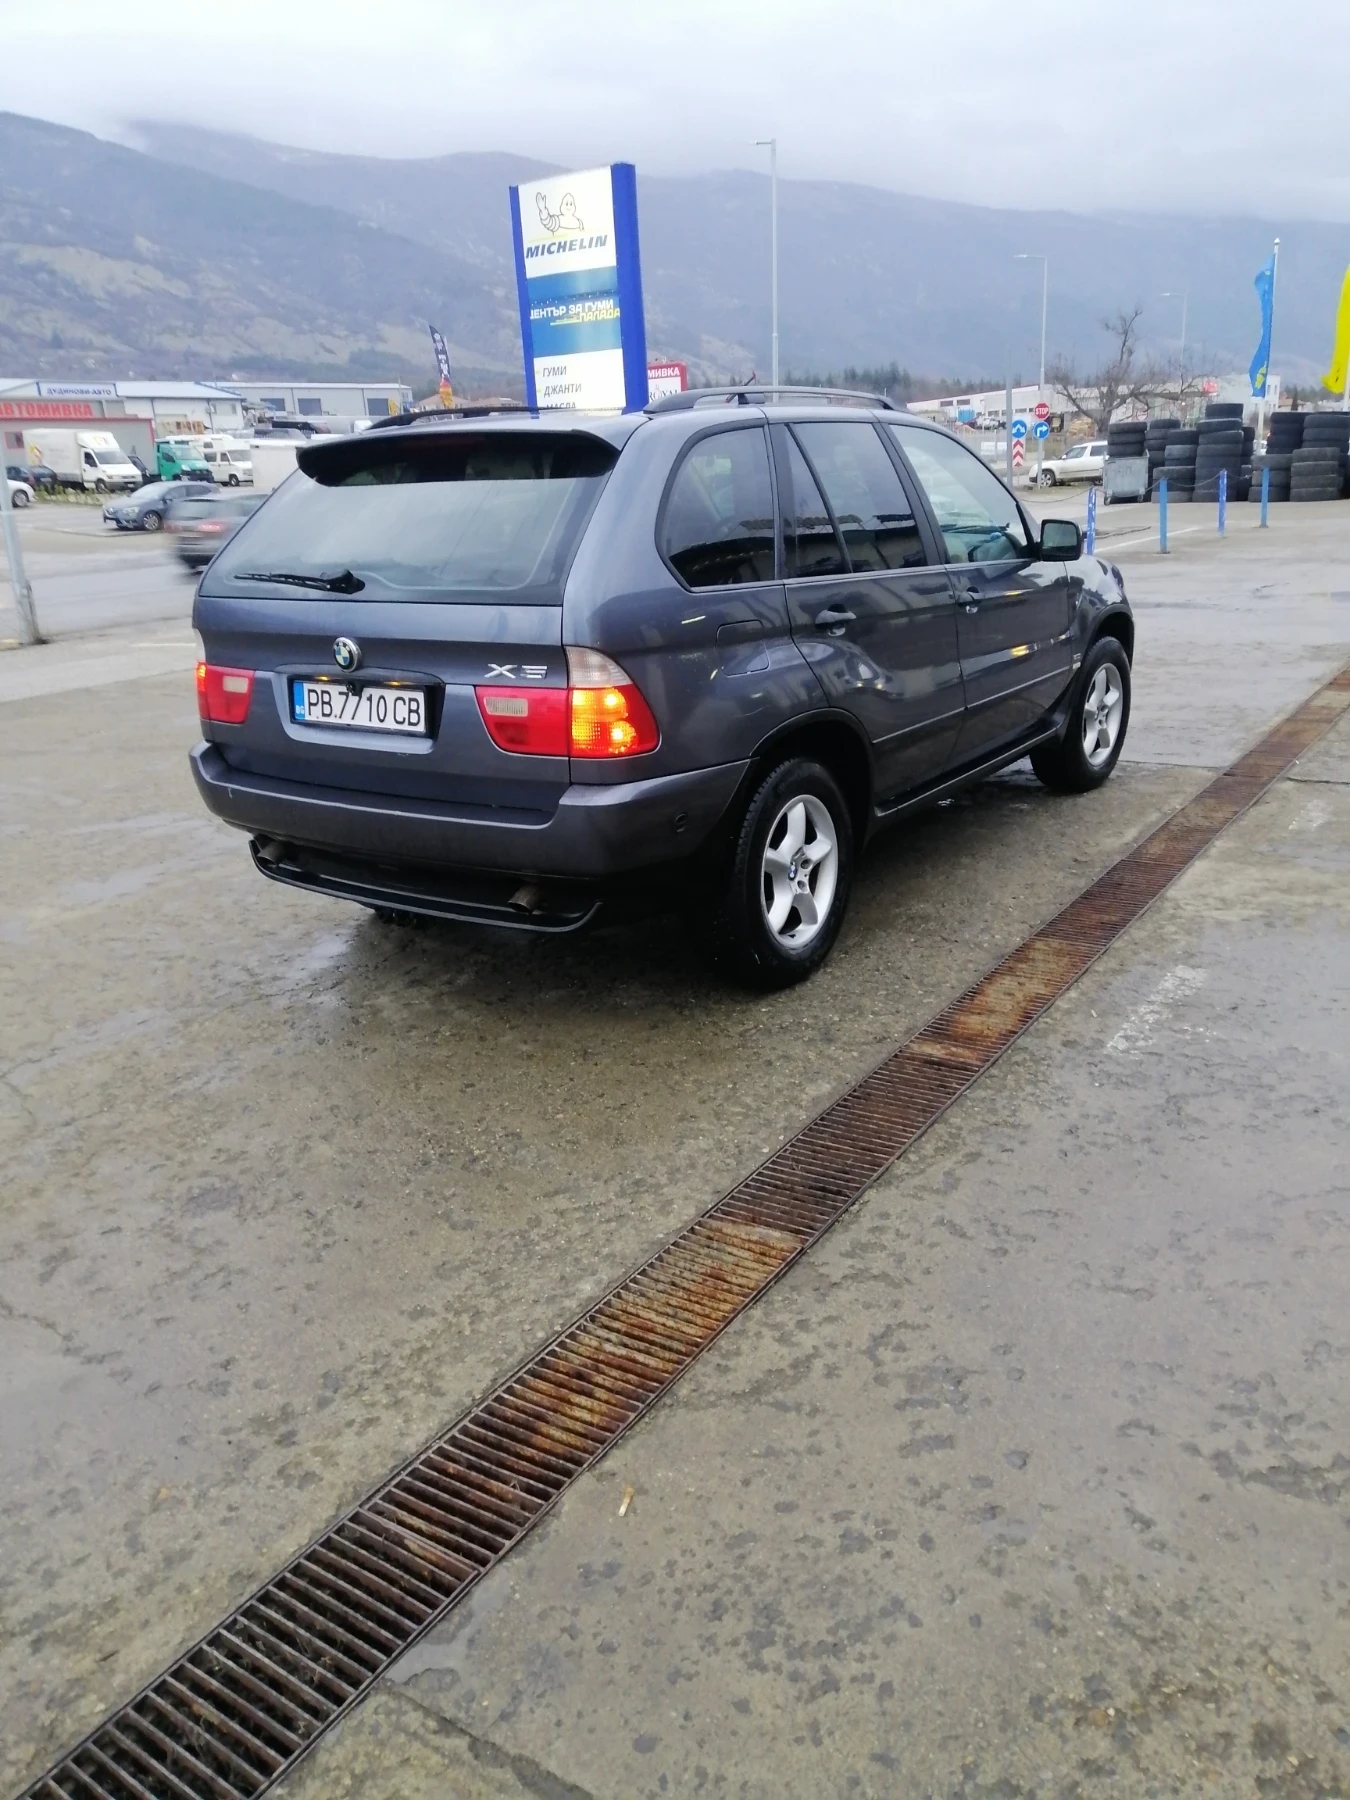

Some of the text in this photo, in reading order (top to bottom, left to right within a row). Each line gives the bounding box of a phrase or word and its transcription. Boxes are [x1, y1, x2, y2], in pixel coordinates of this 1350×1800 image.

[525, 234, 608, 259] MICHELIN
[569, 304, 583, 315] ЗА
[585, 299, 614, 312] ГУМИ
[542, 365, 567, 378] ГУМИ
[647, 366, 681, 379] МИВКА
[544, 383, 582, 398] ДЖАНТИ
[1035, 407, 1049, 415] STOP
[483, 663, 548, 679] X5
